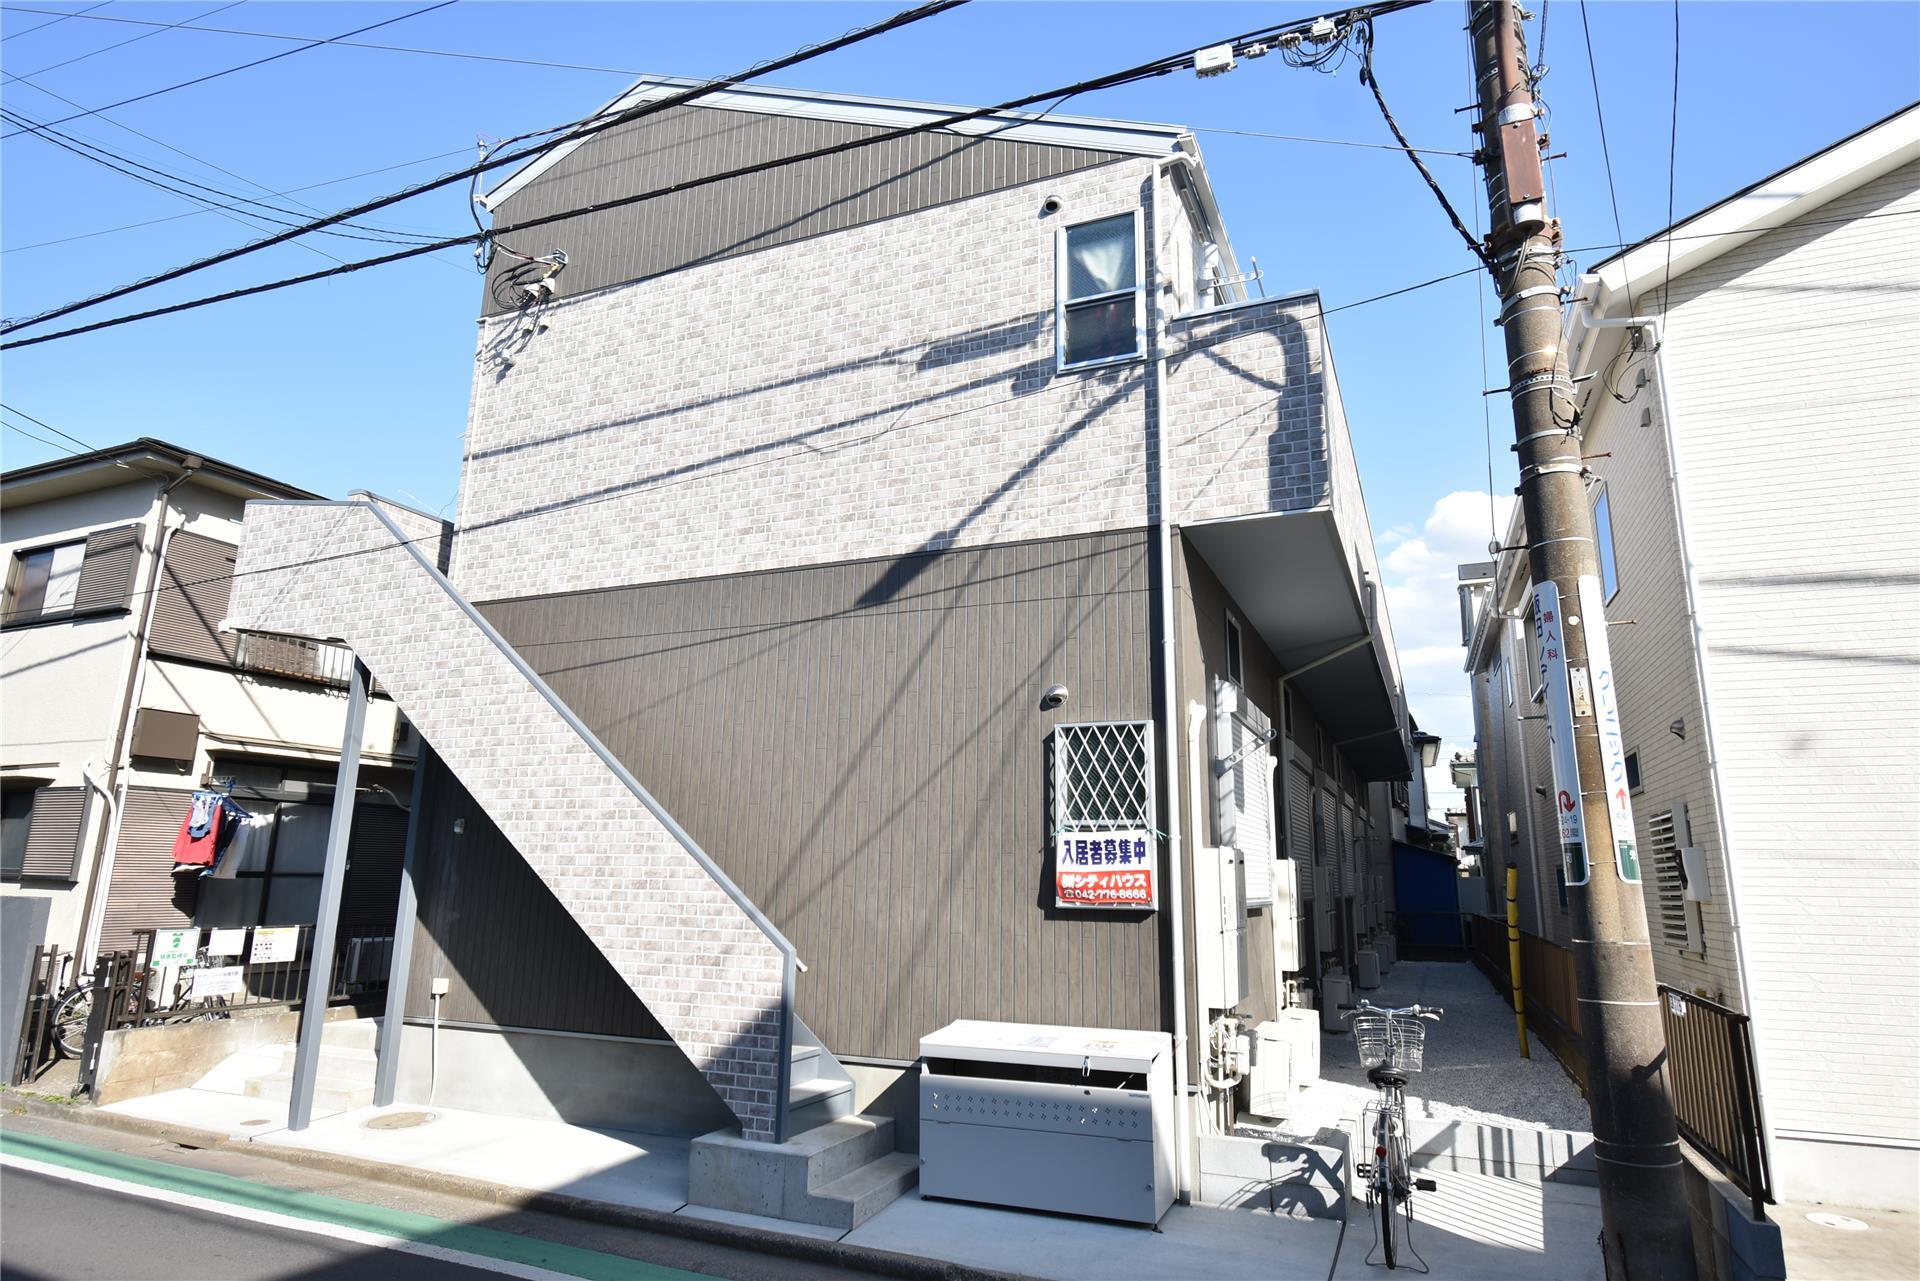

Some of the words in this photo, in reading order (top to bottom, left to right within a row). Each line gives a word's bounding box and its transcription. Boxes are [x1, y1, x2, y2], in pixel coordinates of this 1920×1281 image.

[1543, 611, 1558, 660] 婦人科
[1599, 671, 1622, 782] クリニック
[1062, 838, 1146, 865] 入居者募集中
